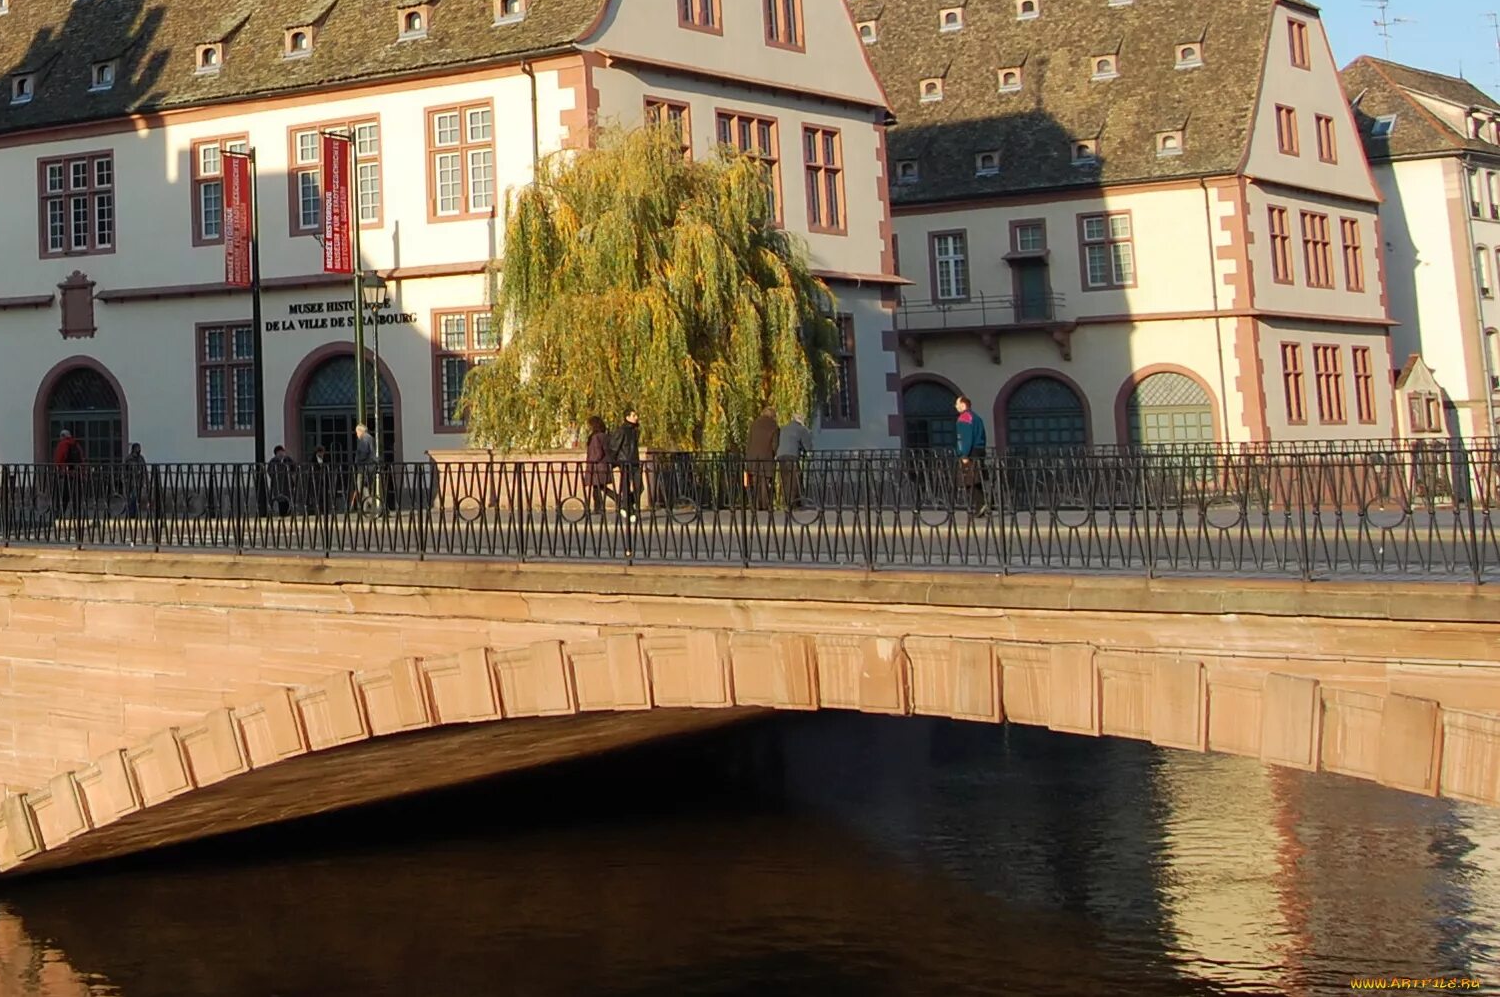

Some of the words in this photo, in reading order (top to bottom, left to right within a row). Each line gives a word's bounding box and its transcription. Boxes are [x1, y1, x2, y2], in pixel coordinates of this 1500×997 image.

[289, 303, 324, 314] MUSEE
[266, 321, 280, 331] DE
[282, 320, 296, 331] LA
[298, 318, 328, 329] VILLE
[330, 316, 345, 328] DE
[347, 312, 417, 327] SRABOURG
